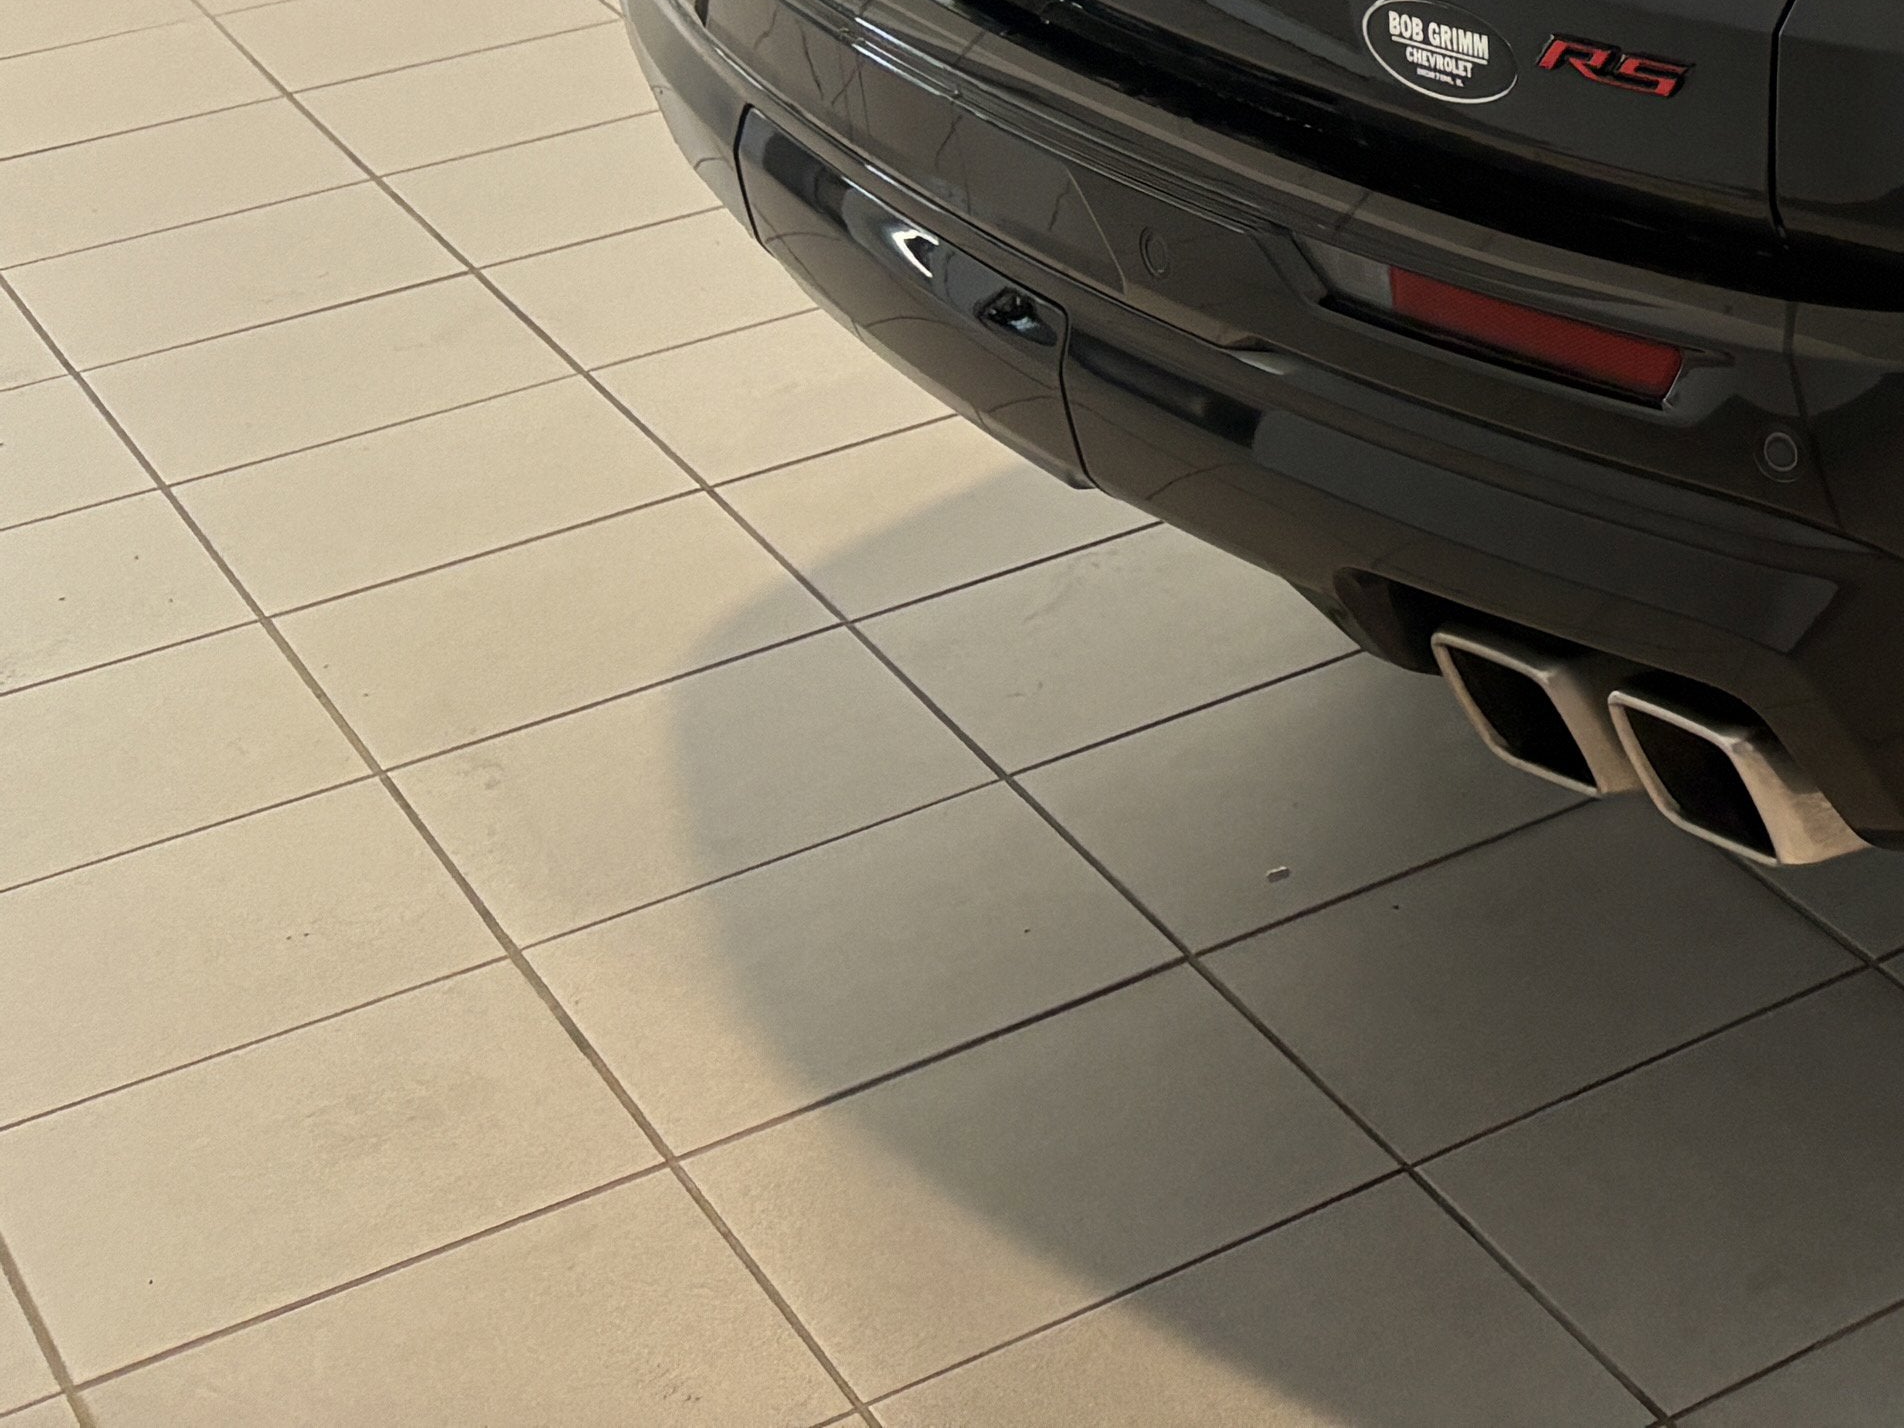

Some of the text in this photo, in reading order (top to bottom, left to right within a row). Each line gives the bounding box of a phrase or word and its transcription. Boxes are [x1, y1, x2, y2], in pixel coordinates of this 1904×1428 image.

[1388, 10, 1489, 59] BOB GRIMM
[1405, 46, 1473, 78] CHEVROLET
[1536, 33, 1696, 98] RS
